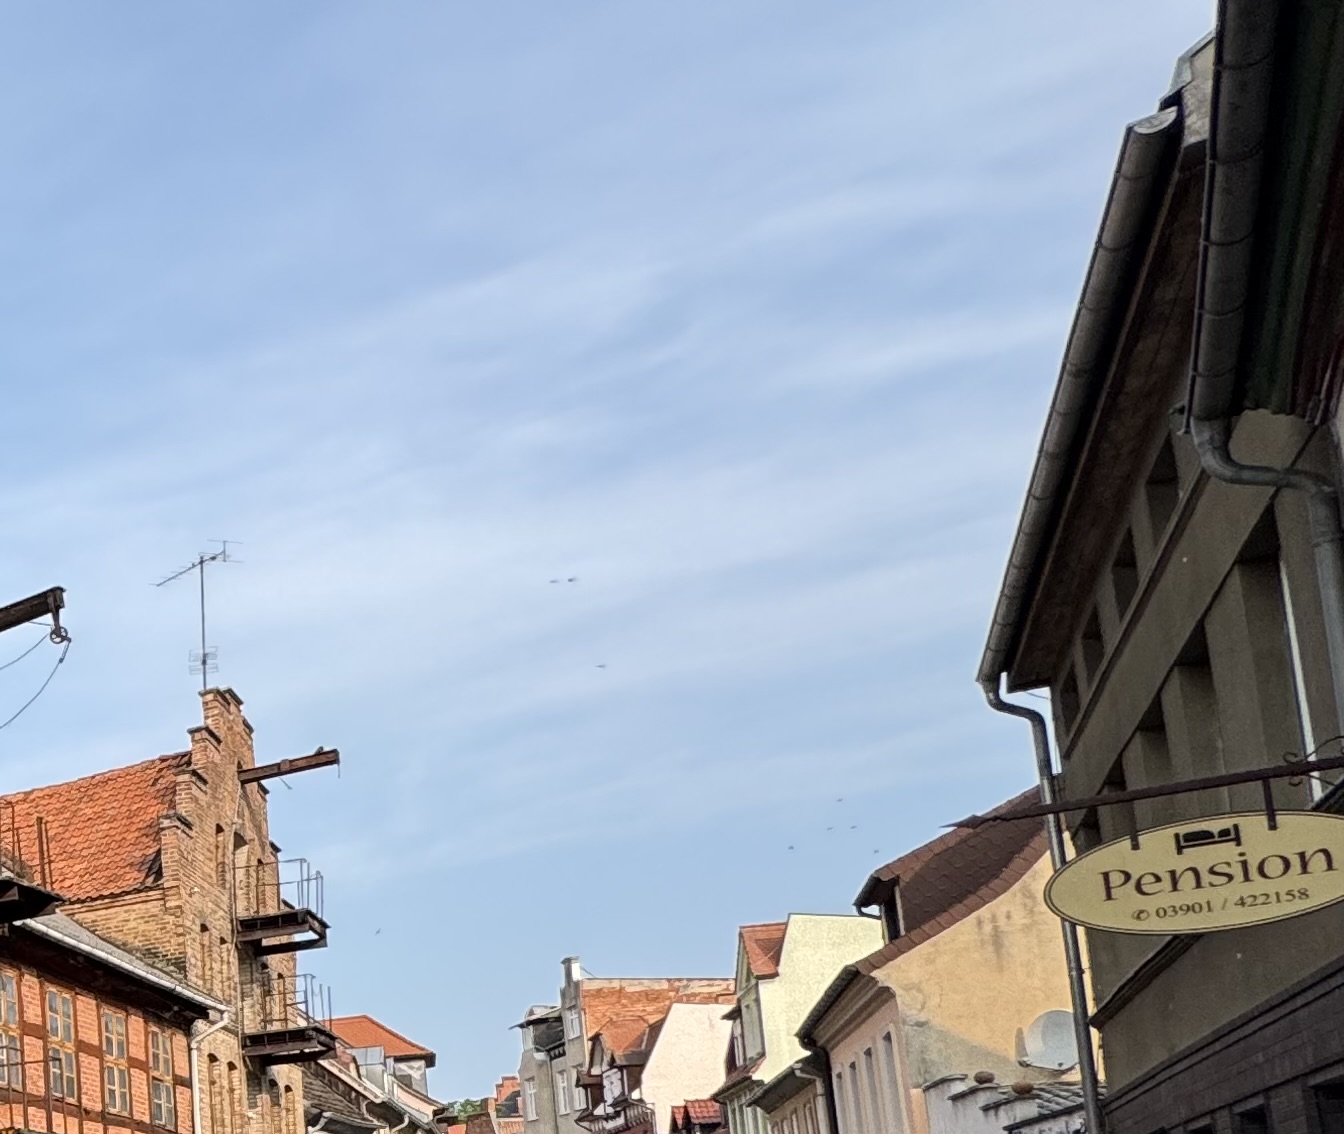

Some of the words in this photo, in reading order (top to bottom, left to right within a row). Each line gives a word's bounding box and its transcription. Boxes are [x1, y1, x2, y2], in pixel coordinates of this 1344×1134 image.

[1098, 848, 1338, 902] Pension
[1155, 901, 1213, 919] 03901
[1234, 887, 1310, 908] 422158
